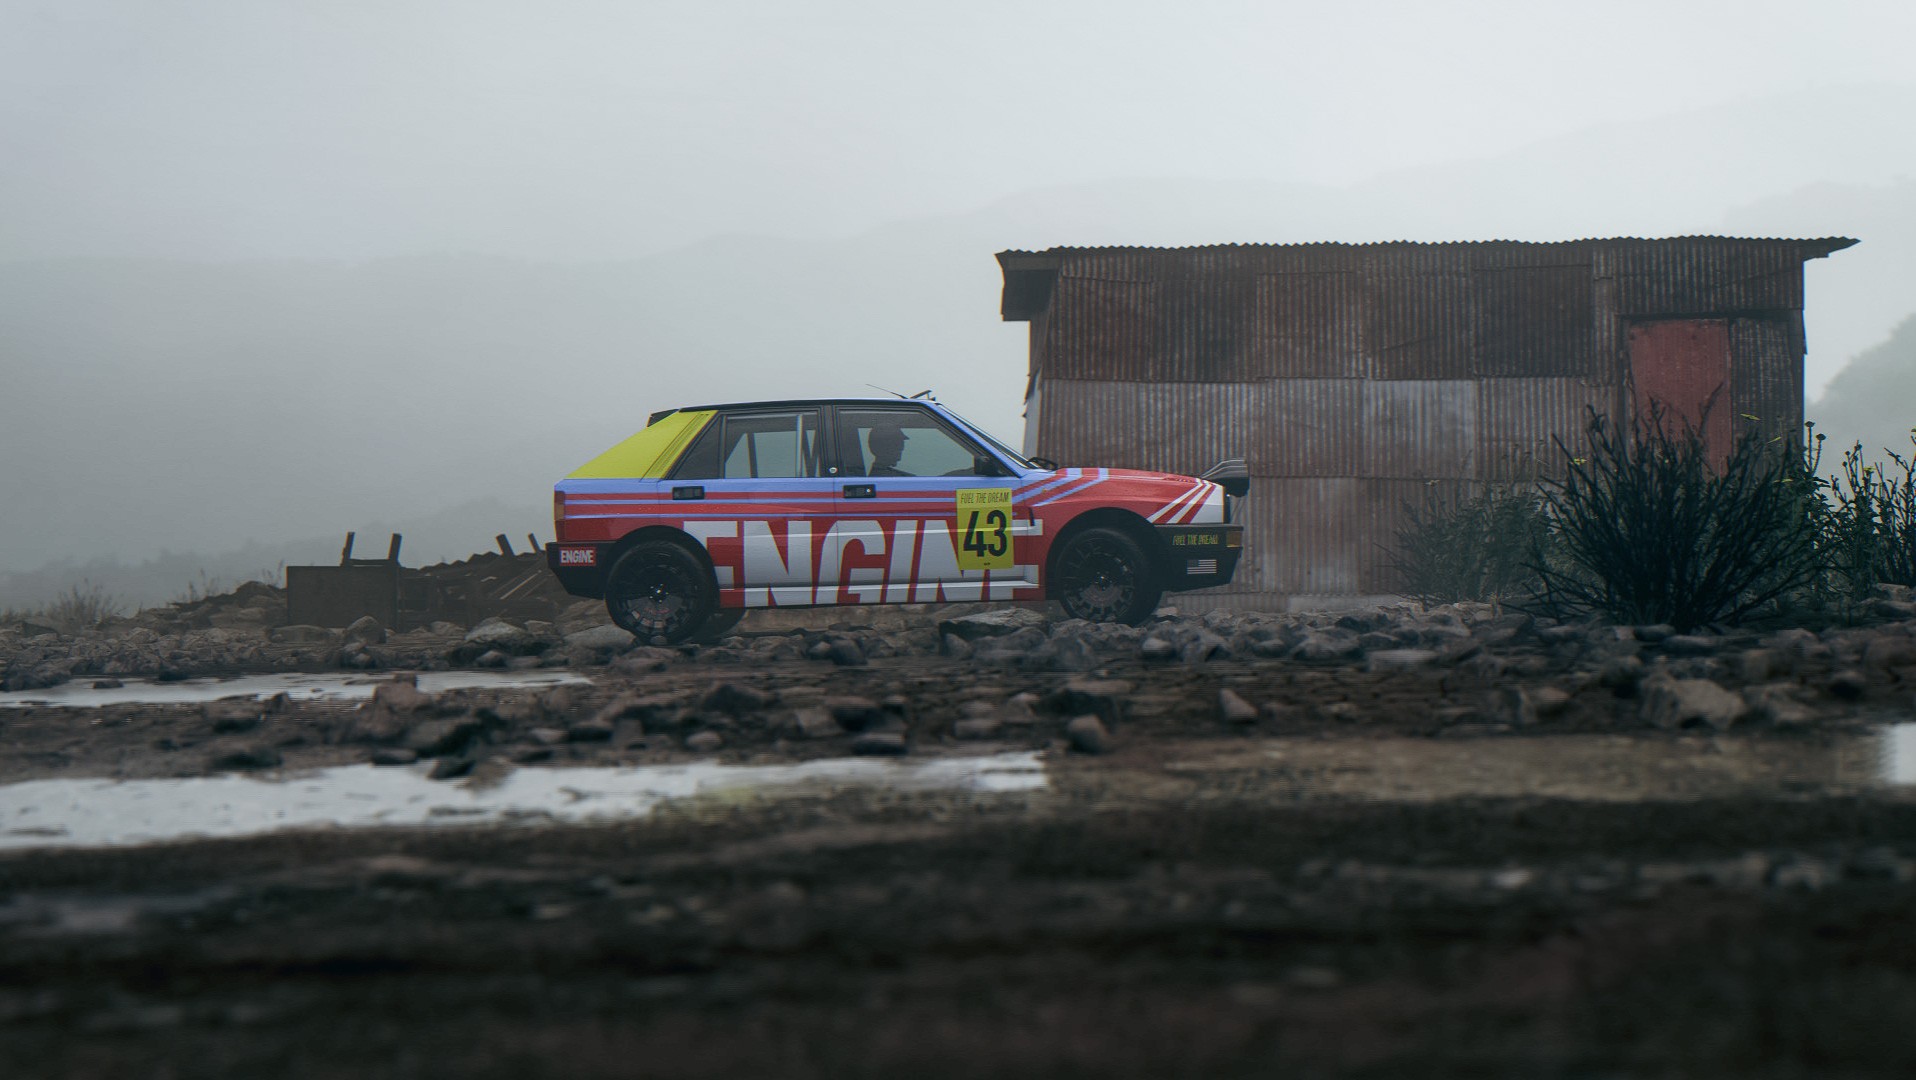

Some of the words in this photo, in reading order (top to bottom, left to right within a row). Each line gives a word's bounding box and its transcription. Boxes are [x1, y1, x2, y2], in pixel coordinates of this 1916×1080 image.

[960, 492, 974, 504] FUEL
[975, 492, 986, 504] THE
[987, 491, 1010, 503] DREAM
[963, 509, 1008, 557] 43
[560, 550, 594, 564] ENGINE
